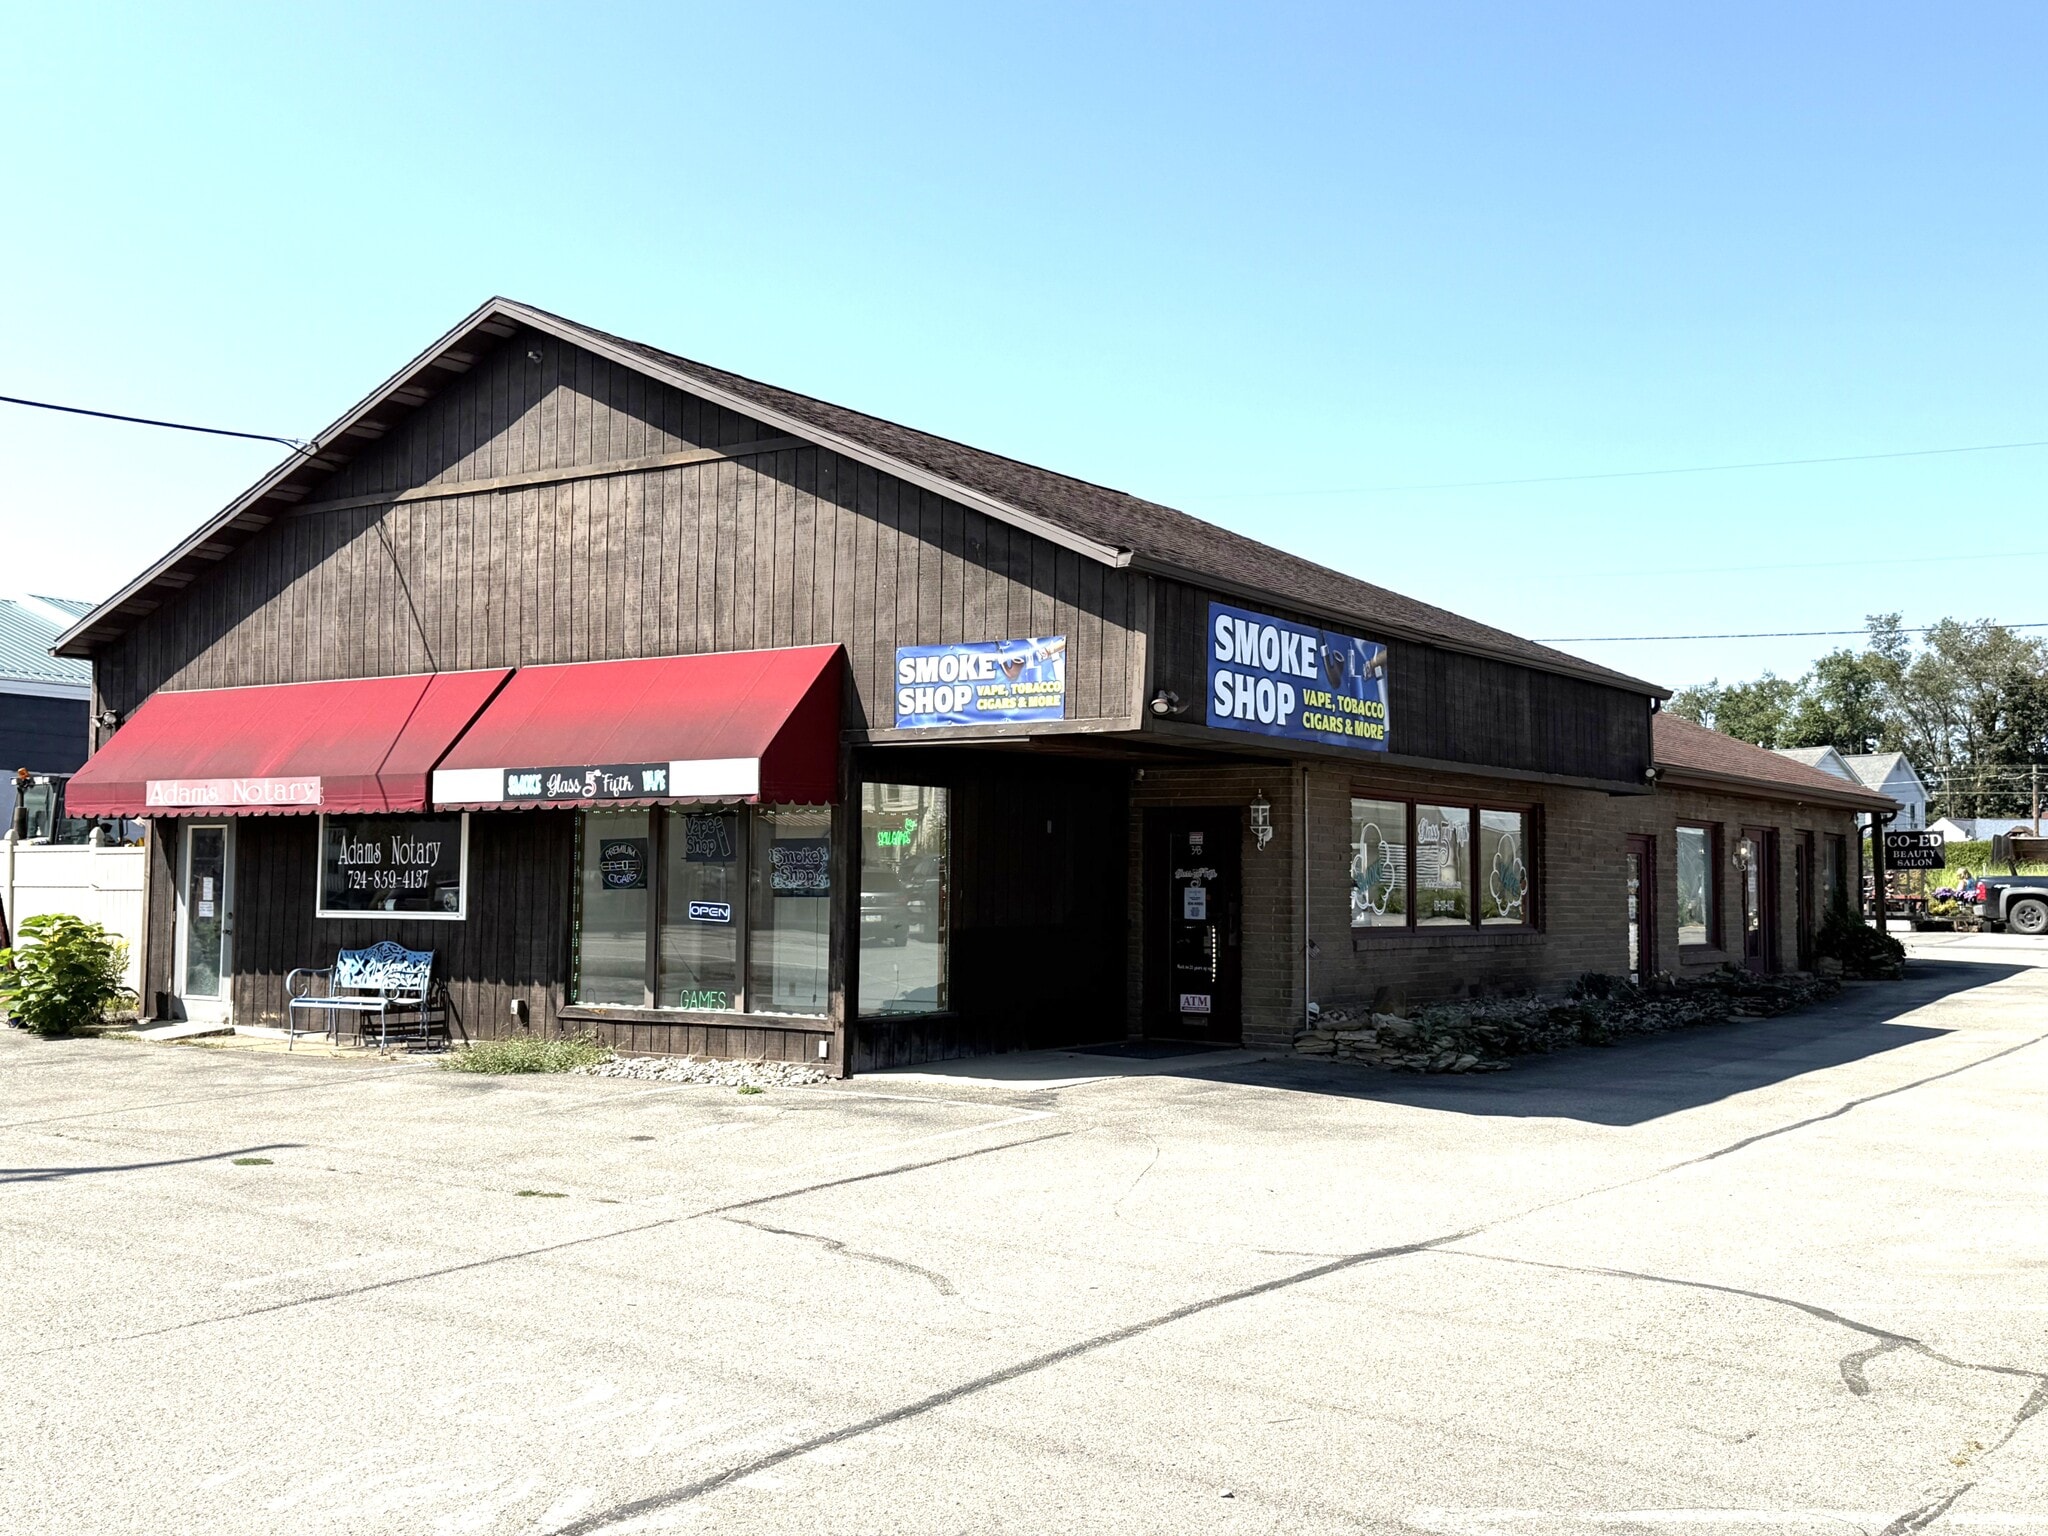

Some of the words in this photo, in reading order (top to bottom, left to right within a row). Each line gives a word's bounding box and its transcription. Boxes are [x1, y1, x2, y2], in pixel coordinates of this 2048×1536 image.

[1214, 614, 1318, 679] SMOKE
[898, 653, 997, 684] SMOKE
[976, 684, 1009, 697] VAPE,
[1010, 680, 1063, 694] TOBACCO
[1214, 669, 1296, 726] SHOP
[898, 685, 972, 715] SHOP
[976, 697, 1017, 710] CIGARS
[1017, 697, 1027, 708] &
[1028, 695, 1061, 708] MORE
[1302, 688, 1336, 713] VAPE,
[1337, 695, 1385, 720] TOBACCO
[1302, 711, 1344, 735] CIGARS
[1344, 718, 1354, 735] &
[1354, 720, 1385, 741] MORE
[150, 781, 219, 804] Adams
[231, 778, 317, 804] Notary
[547, 773, 582, 798] Glass
[602, 773, 634, 797] Fifth
[685, 816, 716, 838] Vape
[338, 835, 382, 865] Adams
[391, 834, 441, 867] Notary
[686, 835, 717, 858] Shop
[1887, 834, 1943, 848] CO-ED
[776, 847, 820, 865] Smoke
[1893, 849, 1936, 858] BEAUTY
[1897, 858, 1933, 867] SALON
[347, 869, 430, 889] 724-859-4137
[608, 871, 638, 884] CIGARS
[779, 865, 817, 885] Shop
[690, 905, 729, 918] OPEN
[680, 989, 727, 1010] GAMES
[1183, 995, 1209, 1007] ATM
